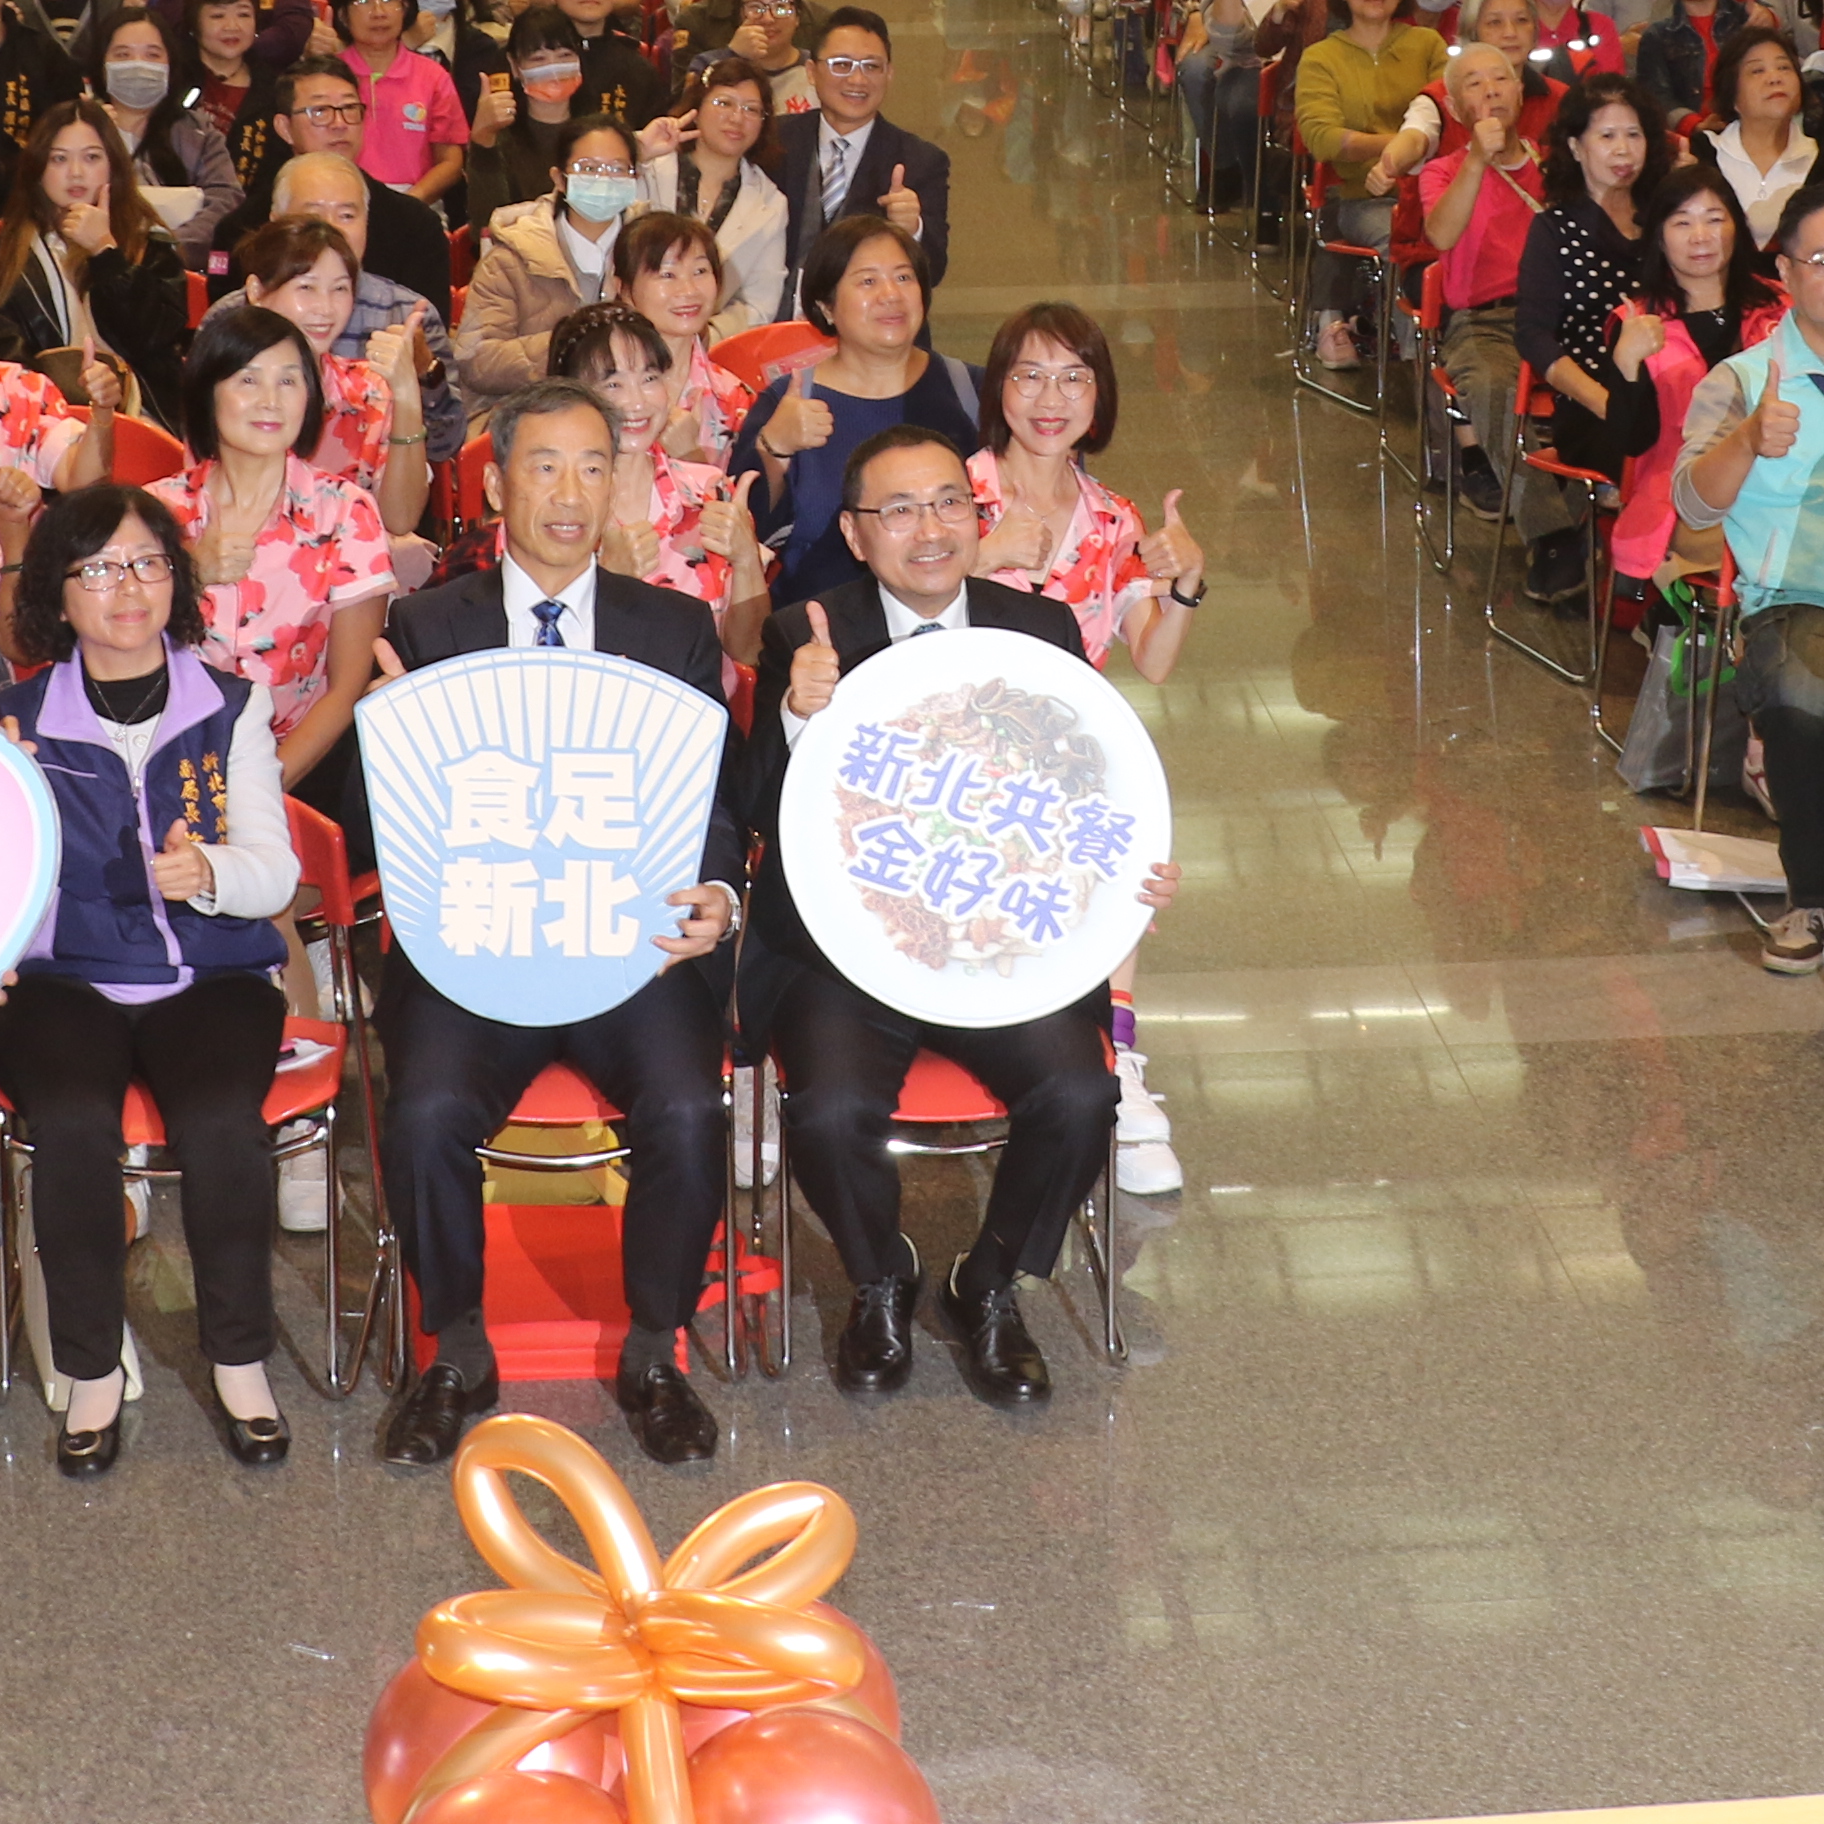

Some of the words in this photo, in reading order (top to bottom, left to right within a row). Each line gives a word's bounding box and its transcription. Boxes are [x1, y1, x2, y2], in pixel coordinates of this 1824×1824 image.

[440, 750, 642, 850] 食足
[839, 723, 1135, 876] 新北共餐
[438, 856, 642, 958] 新北
[849, 820, 1071, 944] 金好味
